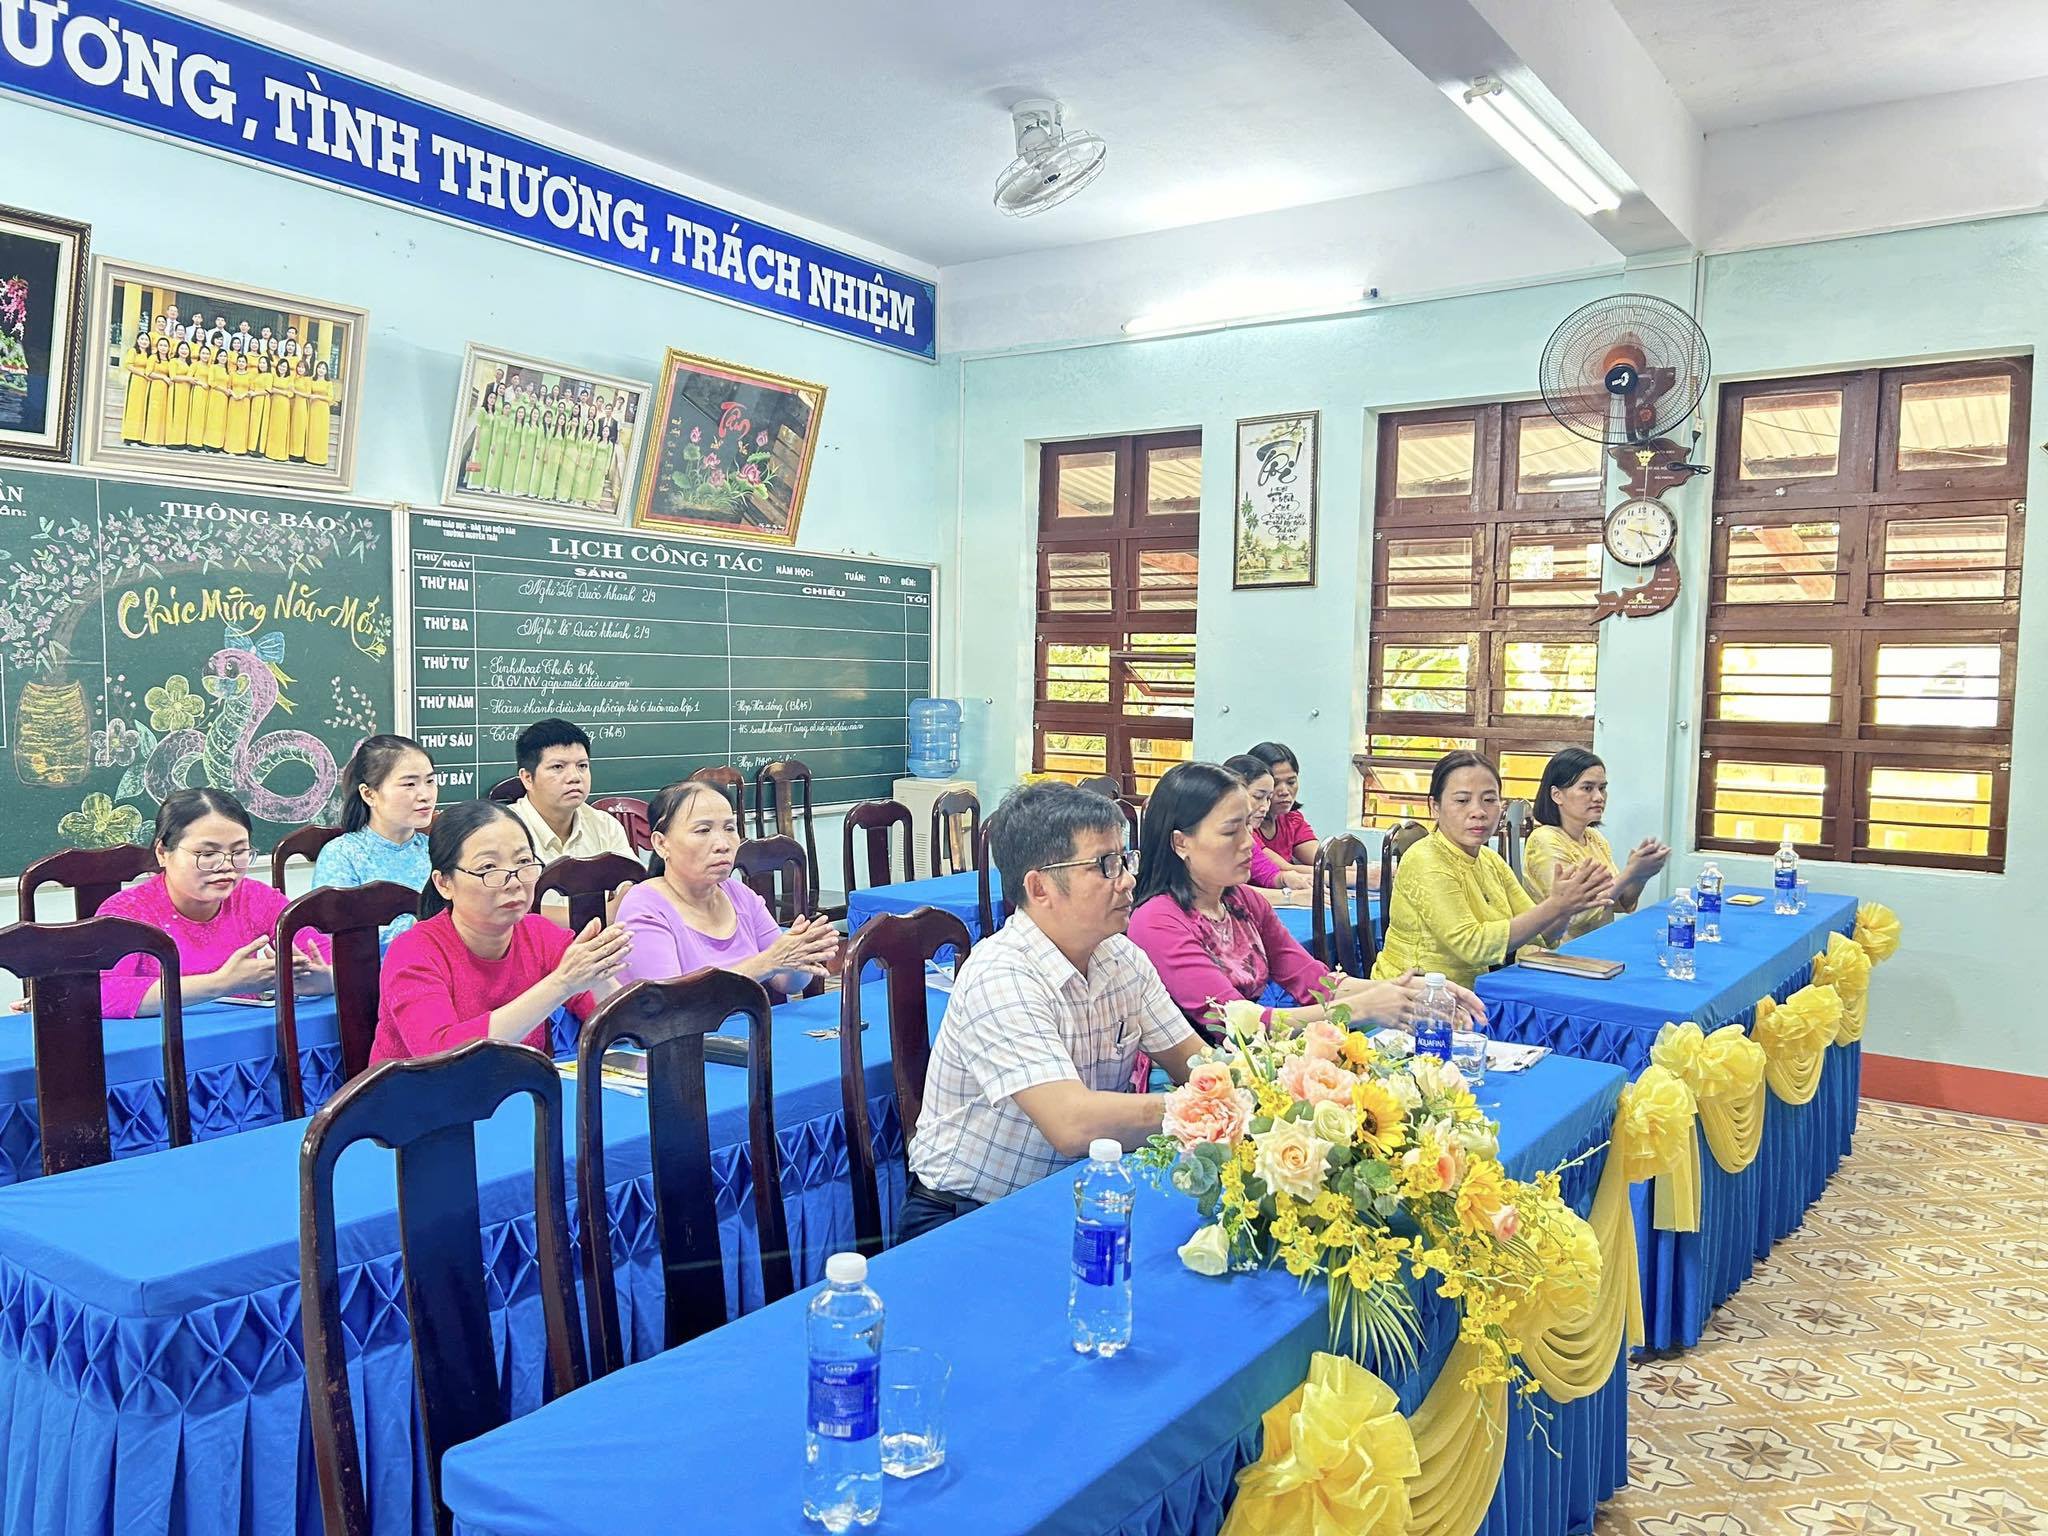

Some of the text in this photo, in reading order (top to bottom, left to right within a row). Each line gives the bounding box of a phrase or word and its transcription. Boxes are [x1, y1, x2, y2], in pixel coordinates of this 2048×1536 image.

[265, 71, 420, 184] TÌNH
[666, 222, 801, 301] TRÁCH
[808, 272, 916, 337] NHIỆM
[160, 501, 337, 532] THÔNG BÁO
[549, 537, 763, 573] LỊCH CÔNG TÁC
[442, 559, 471, 569] NGÀY
[574, 565, 628, 580] SÁNG
[419, 575, 469, 592] THỨ HAI
[641, 588, 657, 603] 2/9
[423, 616, 469, 632] THỨ BA
[633, 625, 650, 639] 2/9
[422, 654, 470, 671] THỨ TƯ
[418, 692, 474, 710] THỨ NĂM
[420, 730, 474, 748] THỨ SÁU
[450, 769, 474, 786] BẢY
